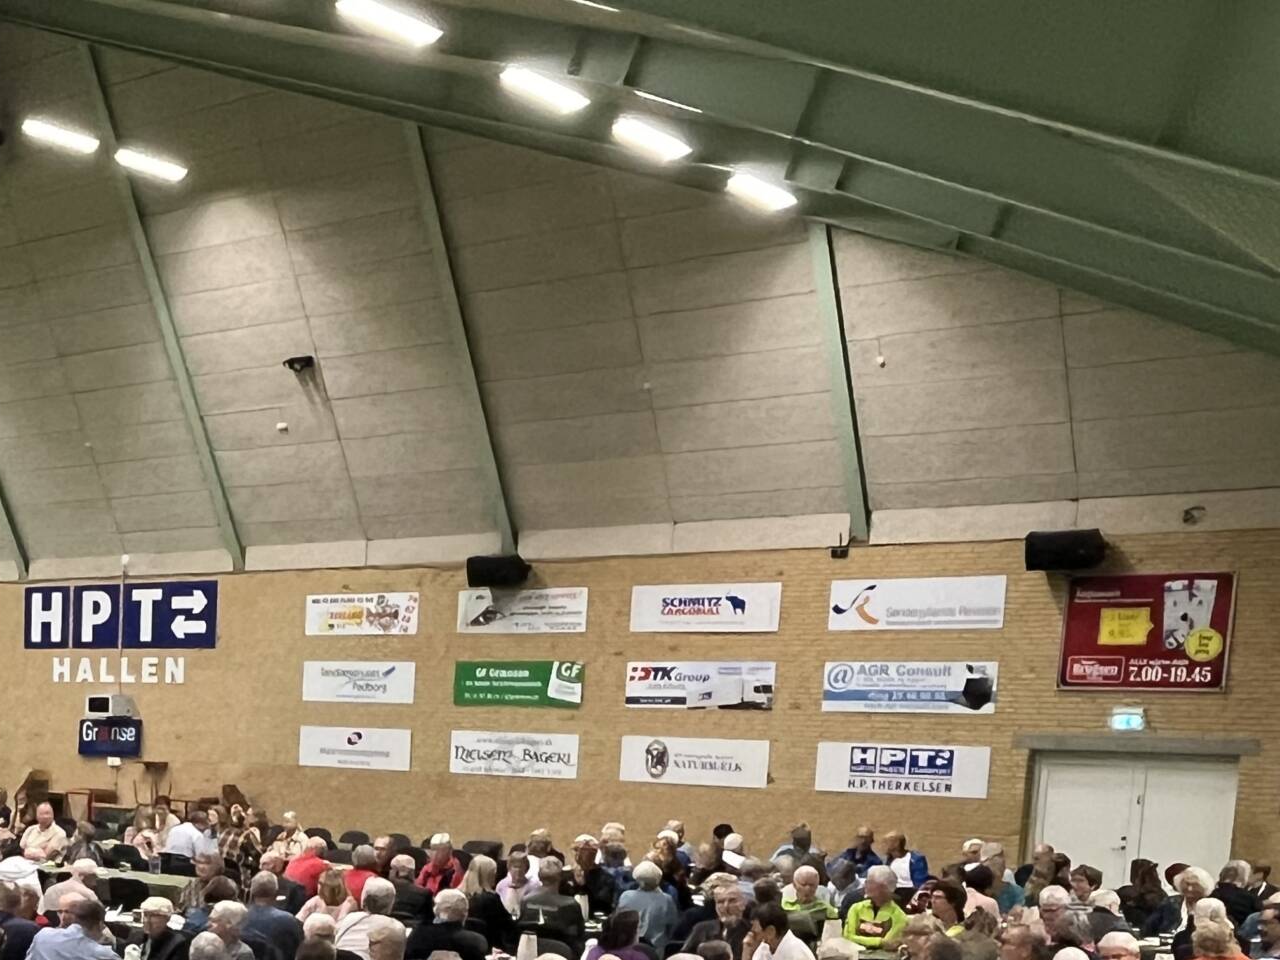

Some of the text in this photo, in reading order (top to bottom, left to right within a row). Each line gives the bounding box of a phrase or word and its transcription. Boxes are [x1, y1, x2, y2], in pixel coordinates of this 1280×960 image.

[661, 597, 723, 608] SCHMITZ
[30, 588, 163, 643] HPT
[52, 656, 185, 684] HALLEN
[561, 662, 582, 678] GF
[675, 672, 710, 683] Group
[856, 664, 890, 677] AGR
[896, 664, 952, 677] Consult
[1128, 666, 1212, 683] 7.00-19.45
